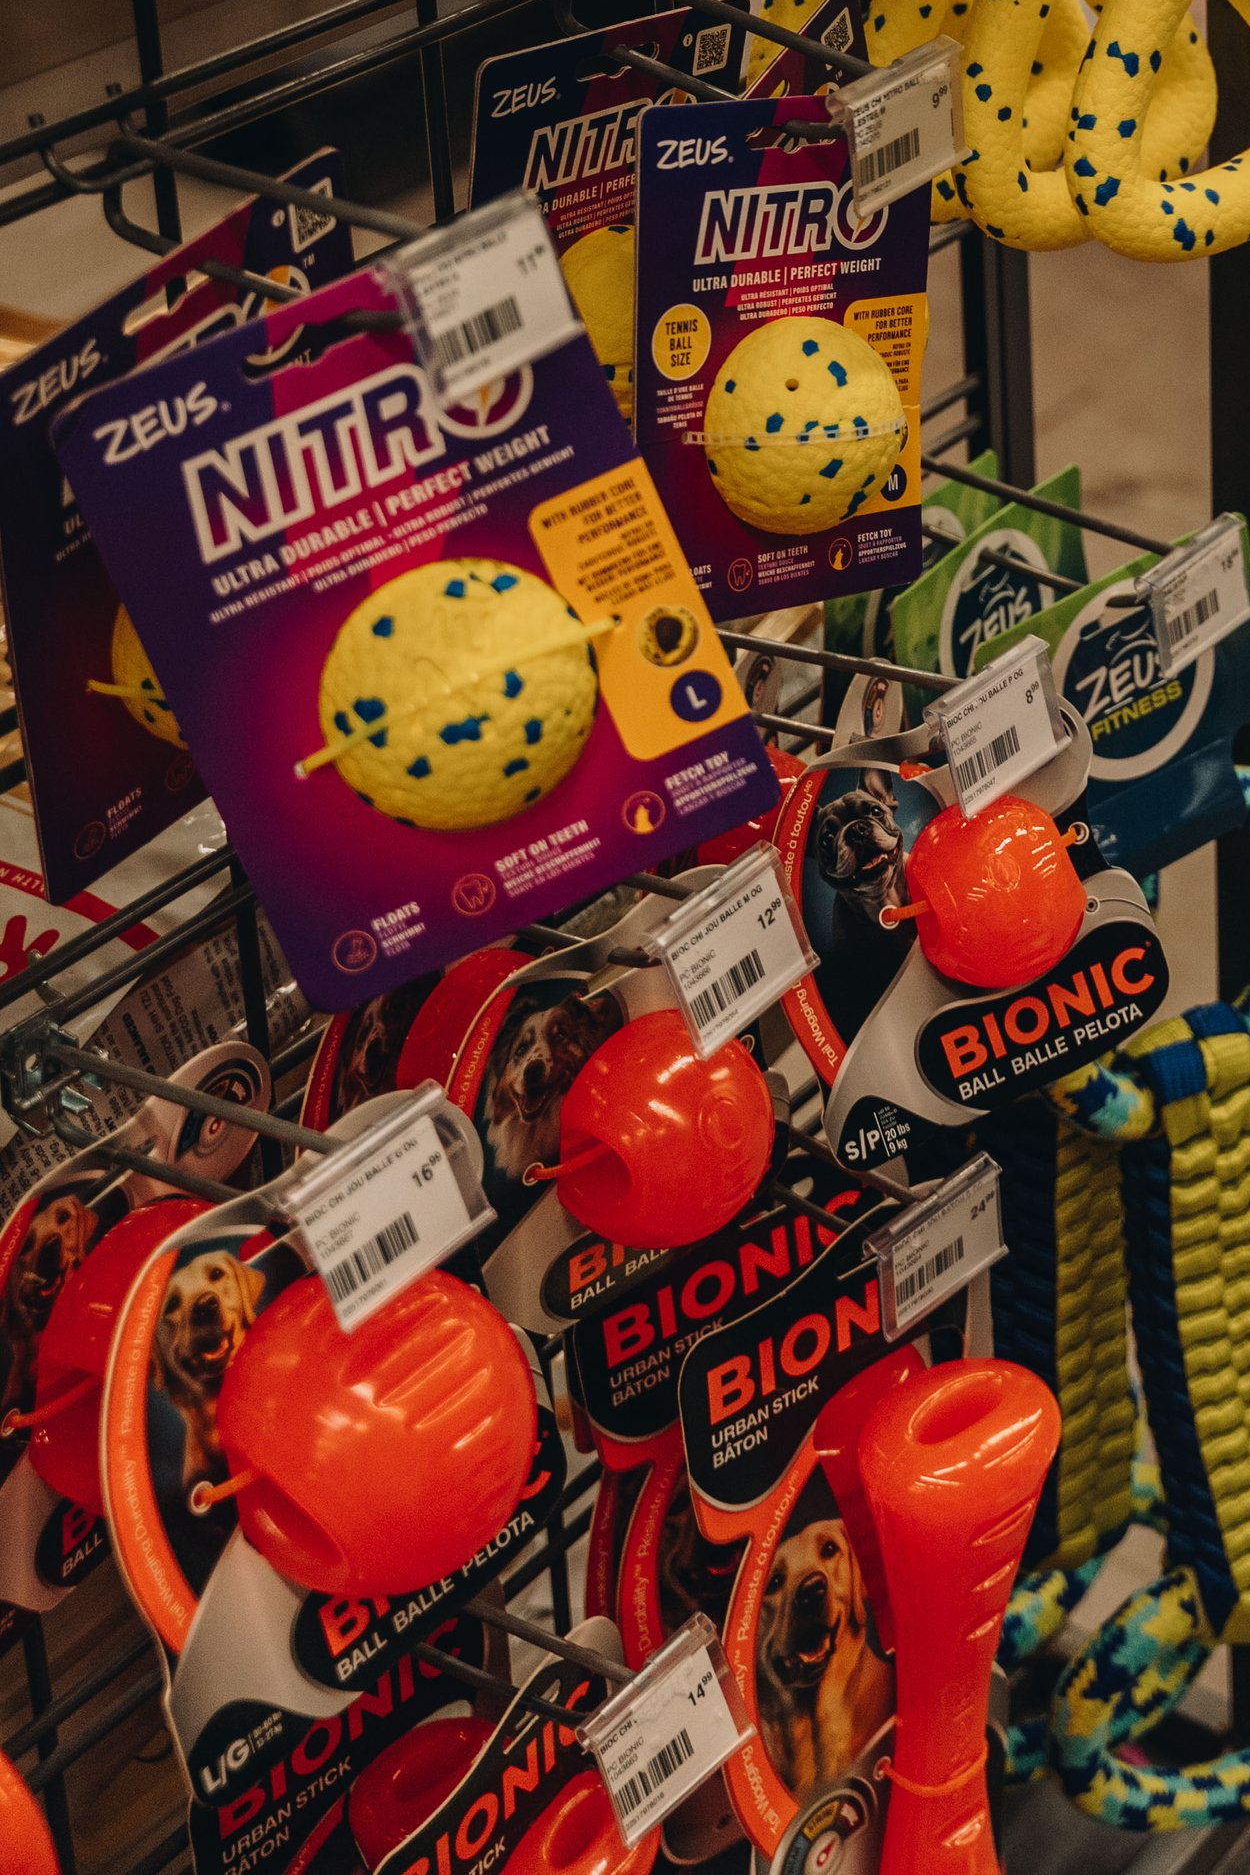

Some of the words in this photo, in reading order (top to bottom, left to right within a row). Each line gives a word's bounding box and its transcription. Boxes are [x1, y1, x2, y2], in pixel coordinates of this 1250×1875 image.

[491, 77, 558, 118] ZEUS
[656, 135, 730, 171] ZEUS
[693, 180, 889, 265] NITRO
[693, 275, 728, 293] ULTRA
[730, 269, 781, 288] DURABLE
[790, 262, 838, 281] PERFECT
[840, 257, 882, 275] WEIGHT
[741, 292, 759, 302] ULTRA
[759, 287, 789, 300] RÉSISTANT
[793, 285, 810, 294] POIDS
[811, 282, 834, 293] OPTIMAL
[737, 302, 756, 313] ULTRA
[757, 299, 778, 310] ROBUST
[782, 294, 812, 307] PERFEKTES
[813, 291, 837, 303] GEWICHT
[740, 312, 757, 321] ULTRA
[758, 307, 788, 319] DURADERO
[792, 305, 806, 315] PESO
[807, 301, 834, 313] PERFECTO
[853, 310, 870, 322] WITH
[871, 307, 896, 319] RUBBER
[897, 305, 914, 316] CORE
[665, 319, 698, 336] TENNIS
[867, 328, 912, 343] PERFORMANCE
[875, 319, 888, 330] FOR
[889, 317, 913, 328] BETTER
[669, 336, 692, 351] BALL
[671, 352, 691, 368] SIZE
[11, 338, 101, 426] ZEUS
[93, 381, 219, 466] ZEUS
[181, 363, 534, 564] NITRO
[888, 474, 899, 492] M
[211, 555, 281, 598] ULTRA
[279, 501, 374, 567] DURABLE
[385, 461, 472, 518] PERFECT
[473, 425, 551, 475] WEIGHT
[757, 552, 775, 564] SOFT
[775, 550, 786, 560] ON
[787, 545, 808, 557] TEETH
[858, 530, 879, 543] FETCH
[879, 528, 893, 539] TOY
[858, 542, 907, 557] APPORTIERSPIELZEUG
[959, 590, 1035, 646] ZEUS
[685, 684, 708, 710] L
[947, 709, 968, 730] BIOC
[987, 682, 1008, 704] BALLE
[1013, 668, 1025, 683] OG
[1075, 647, 1166, 728] ZEU
[1091, 680, 1184, 741] FITNESS
[950, 735, 962, 750] PC
[961, 720, 983, 741] BIONIC
[664, 763, 699, 791] FETCH
[700, 750, 731, 775] TOY
[107, 787, 143, 819] FLOATS
[495, 847, 529, 874] SOFT
[528, 836, 550, 858] ON
[548, 820, 590, 847] TEETH
[372, 901, 421, 931] FLOATS
[670, 942, 690, 962] BIOC
[690, 931, 704, 946] CHI
[704, 920, 720, 936] JOU
[719, 901, 743, 925] BALLE
[750, 883, 764, 899] OG
[679, 967, 692, 983] PC
[691, 949, 717, 974] BIONIC
[137, 989, 154, 1009] TZU
[796, 986, 826, 1046] Wagging
[939, 946, 1156, 1079] BIONIC
[119, 1012, 154, 1065] BALANCED
[147, 1010, 165, 1034] SHIH
[817, 1042, 839, 1069] Tail
[957, 1068, 1006, 1102] BALL
[1010, 1036, 1069, 1076] BALLE
[1075, 1002, 1144, 1050] PELOTA
[844, 1127, 881, 1162] S/P
[884, 1127, 898, 1144] 20
[897, 1121, 911, 1138] lbs
[889, 1141, 898, 1154] 9
[897, 1135, 909, 1153] kg
[304, 1204, 330, 1227] BIOC
[328, 1191, 346, 1210] CHI
[345, 1176, 365, 1196] JOU
[364, 1155, 395, 1181] BALLE
[403, 1137, 419, 1153] OG
[315, 1234, 329, 1250] PC
[328, 1211, 360, 1239] BIONIC
[570, 1274, 616, 1310] BALL
[609, 1347, 672, 1390] URBAN
[674, 1316, 725, 1355] STICK
[706, 1278, 881, 1426] BION
[611, 1365, 671, 1407] BÂTON
[711, 1407, 770, 1449] URBAN
[772, 1375, 821, 1416] STICK
[712, 1425, 769, 1469] BÂTON
[62, 1534, 103, 1578] BALL
[336, 1635, 388, 1684] BALL
[392, 1574, 457, 1634] BALLE
[461, 1510, 536, 1578] PELOTA
[600, 1735, 619, 1755] BIOC
[619, 1720, 633, 1737] CHI
[607, 1762, 619, 1775] PC
[618, 1736, 645, 1765] BIONIC
[201, 1736, 250, 1795] L/G
[740, 1745, 771, 1812] Wagging
[222, 1801, 293, 1865] URBAN
[295, 1756, 352, 1810] STICK
[758, 1806, 781, 1834] Tail
